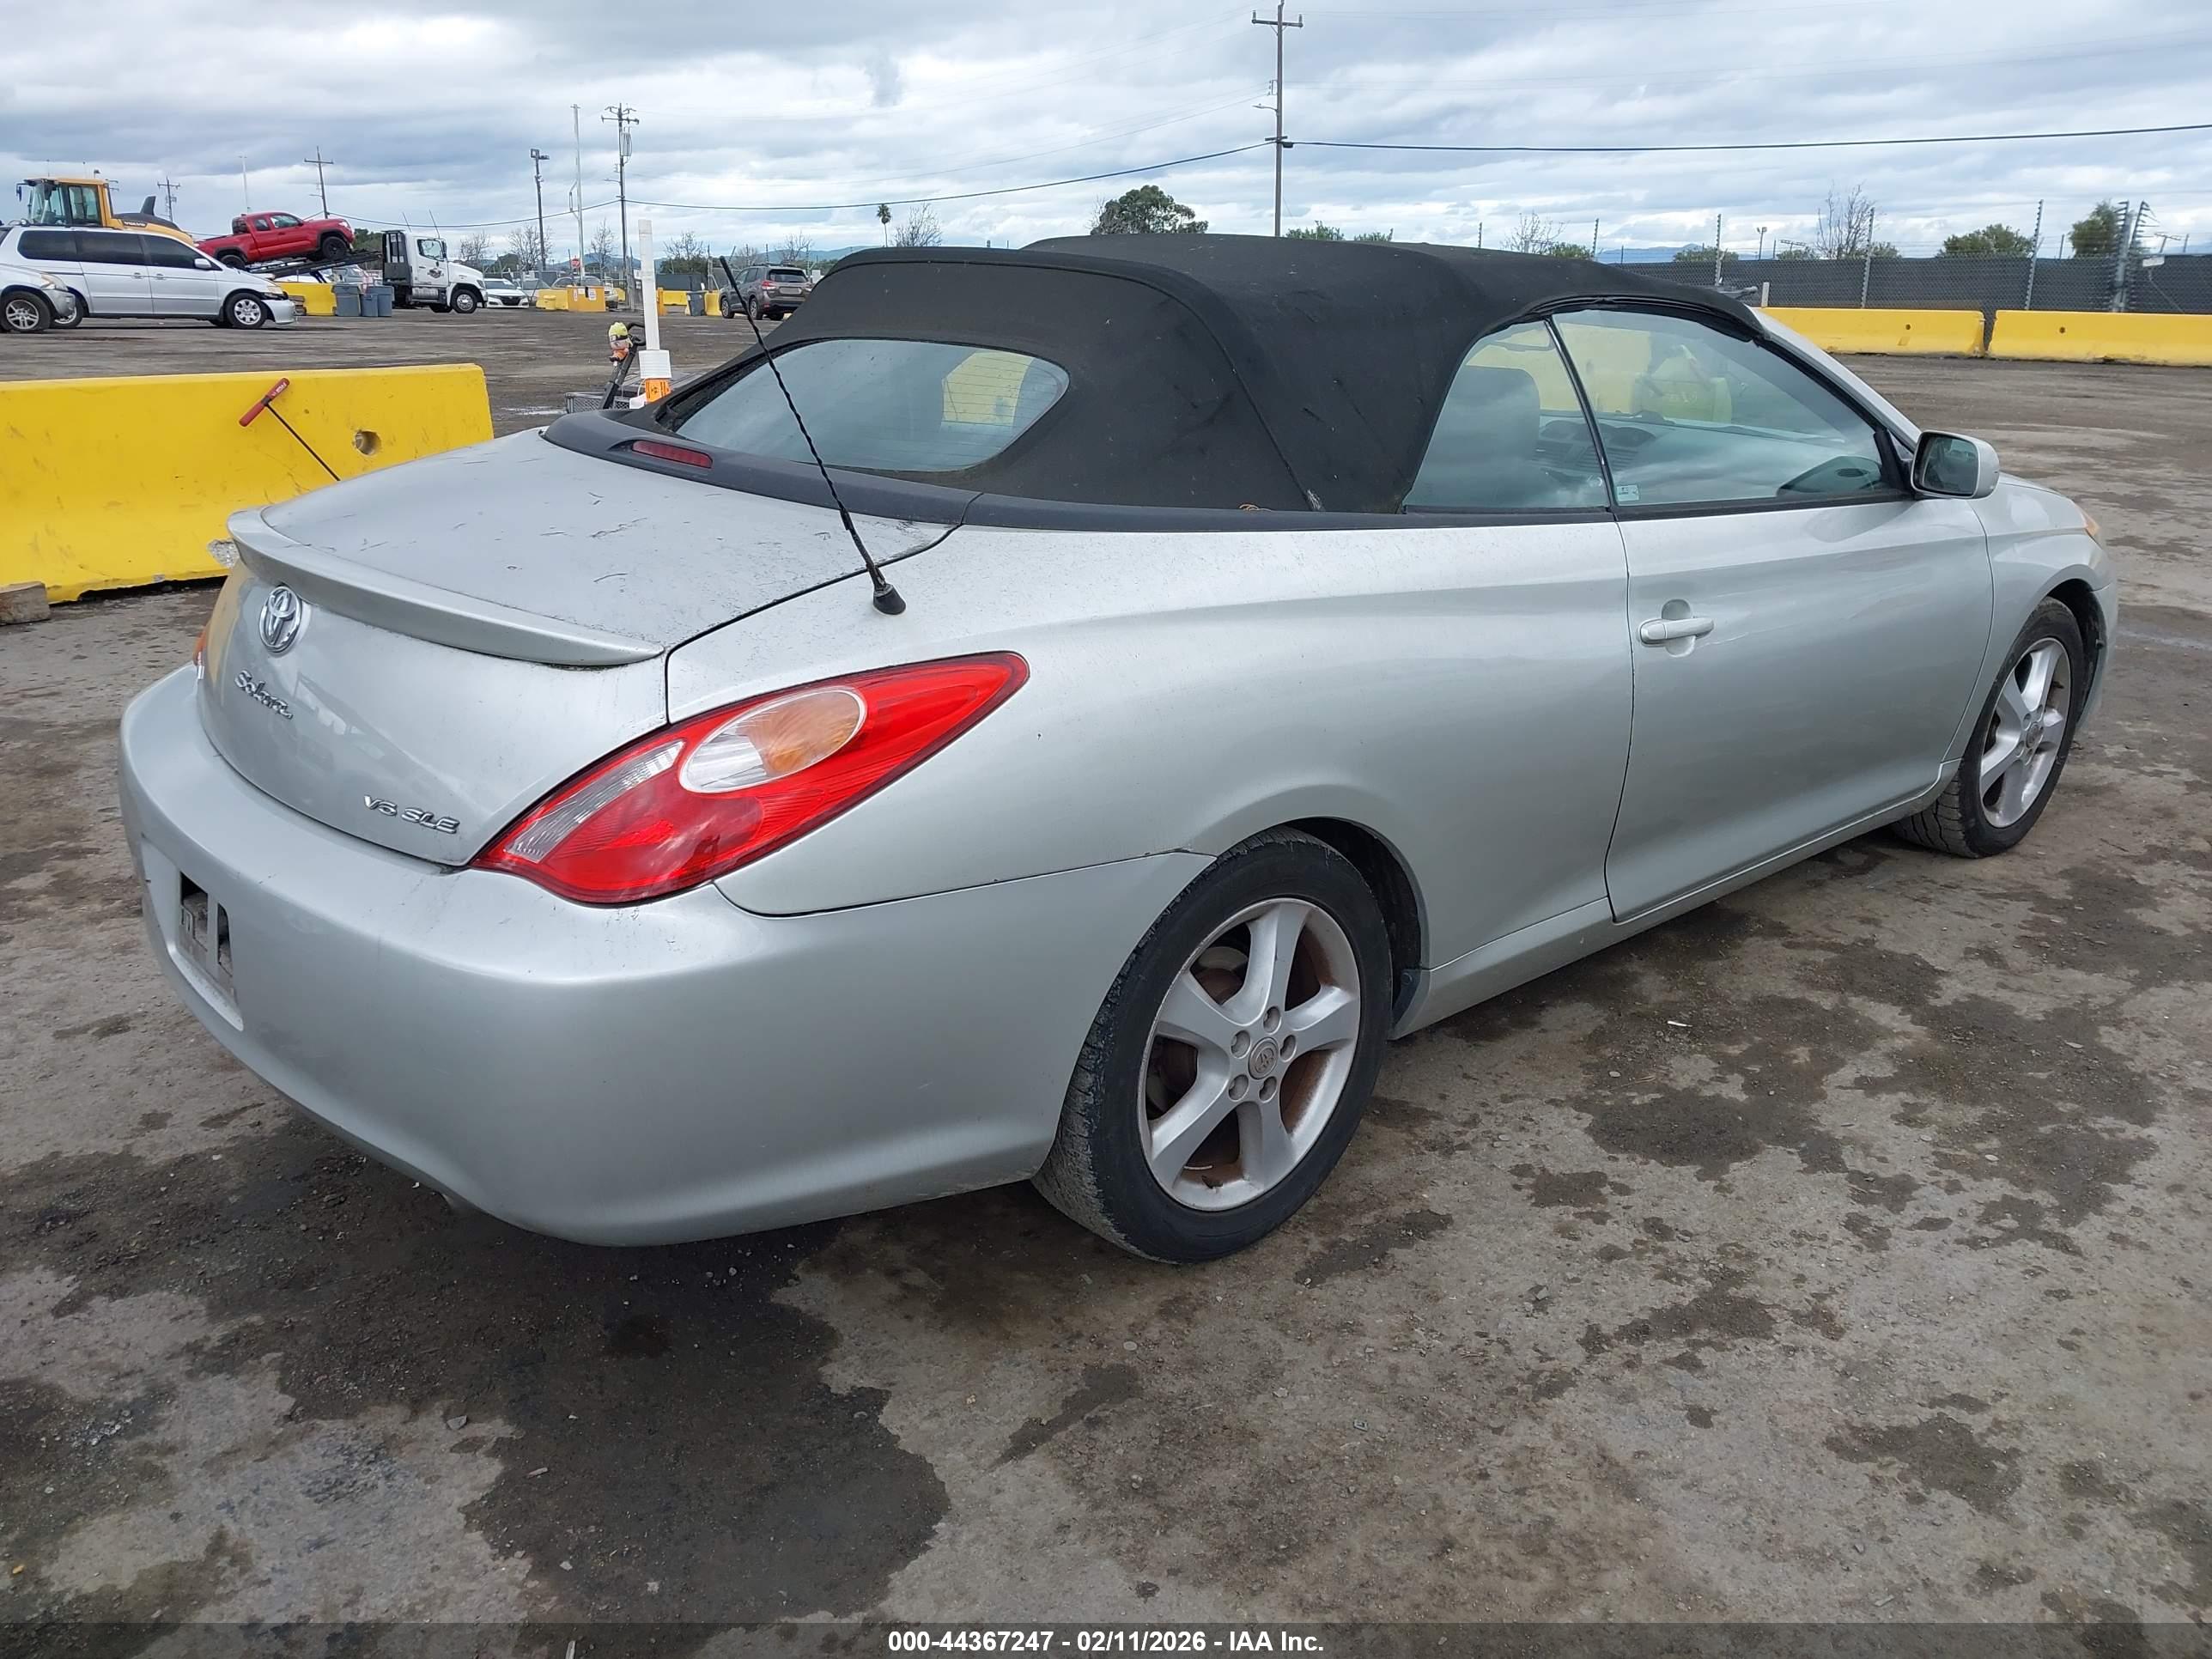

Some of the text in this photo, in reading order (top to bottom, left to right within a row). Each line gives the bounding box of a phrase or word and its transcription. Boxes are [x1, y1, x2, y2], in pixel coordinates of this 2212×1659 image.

[234, 669, 294, 720] Solara
[363, 794, 460, 835] V6 SLE
